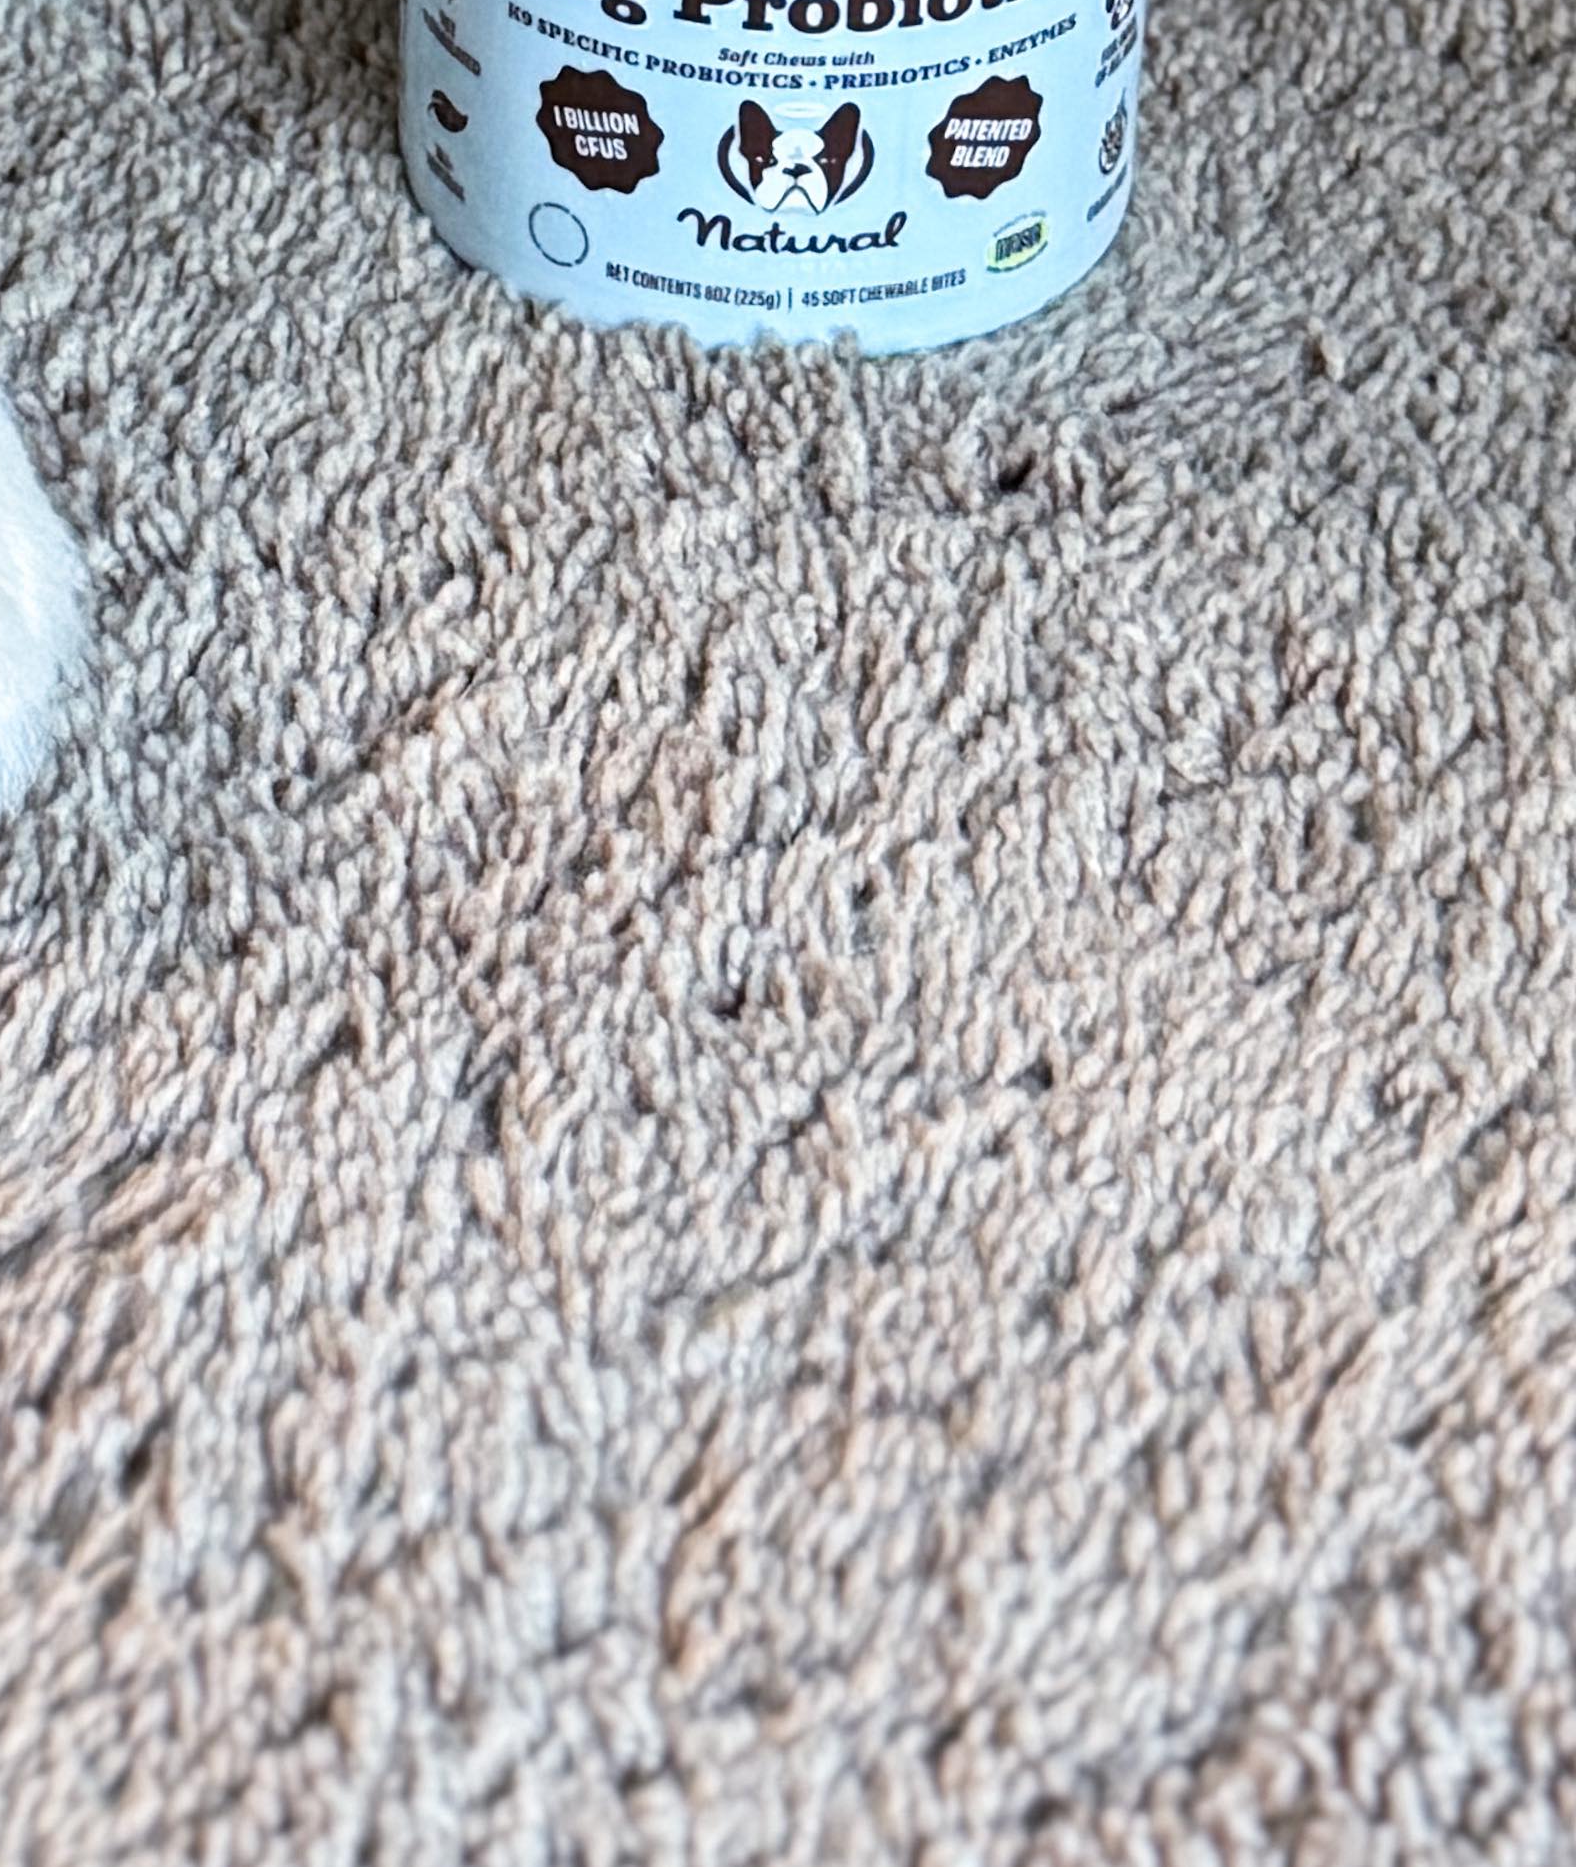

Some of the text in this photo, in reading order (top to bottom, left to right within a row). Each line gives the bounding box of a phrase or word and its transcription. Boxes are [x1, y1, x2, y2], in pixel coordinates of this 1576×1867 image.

[507, 1, 533, 27] K9
[536, 17, 641, 66] SPECIFIC
[645, 53, 803, 90] PROBIOTICS
[823, 55, 972, 91] PREBIOTICS
[987, 12, 1077, 64] ENZYMES
[717, 47, 876, 67] Soft Chews with
[563, 106, 640, 135] BILLION
[943, 117, 1034, 141] PATENTED
[574, 134, 628, 161] CFUS
[949, 144, 1012, 168] BLEND
[676, 207, 908, 254] Natural
[631, 268, 703, 301] CONTENTS
[734, 286, 782, 312] (225g)
[801, 290, 820, 307] 45
[822, 287, 856, 307] SOFT
[858, 276, 929, 304] CHEWABLE
[931, 267, 967, 293] BITES
